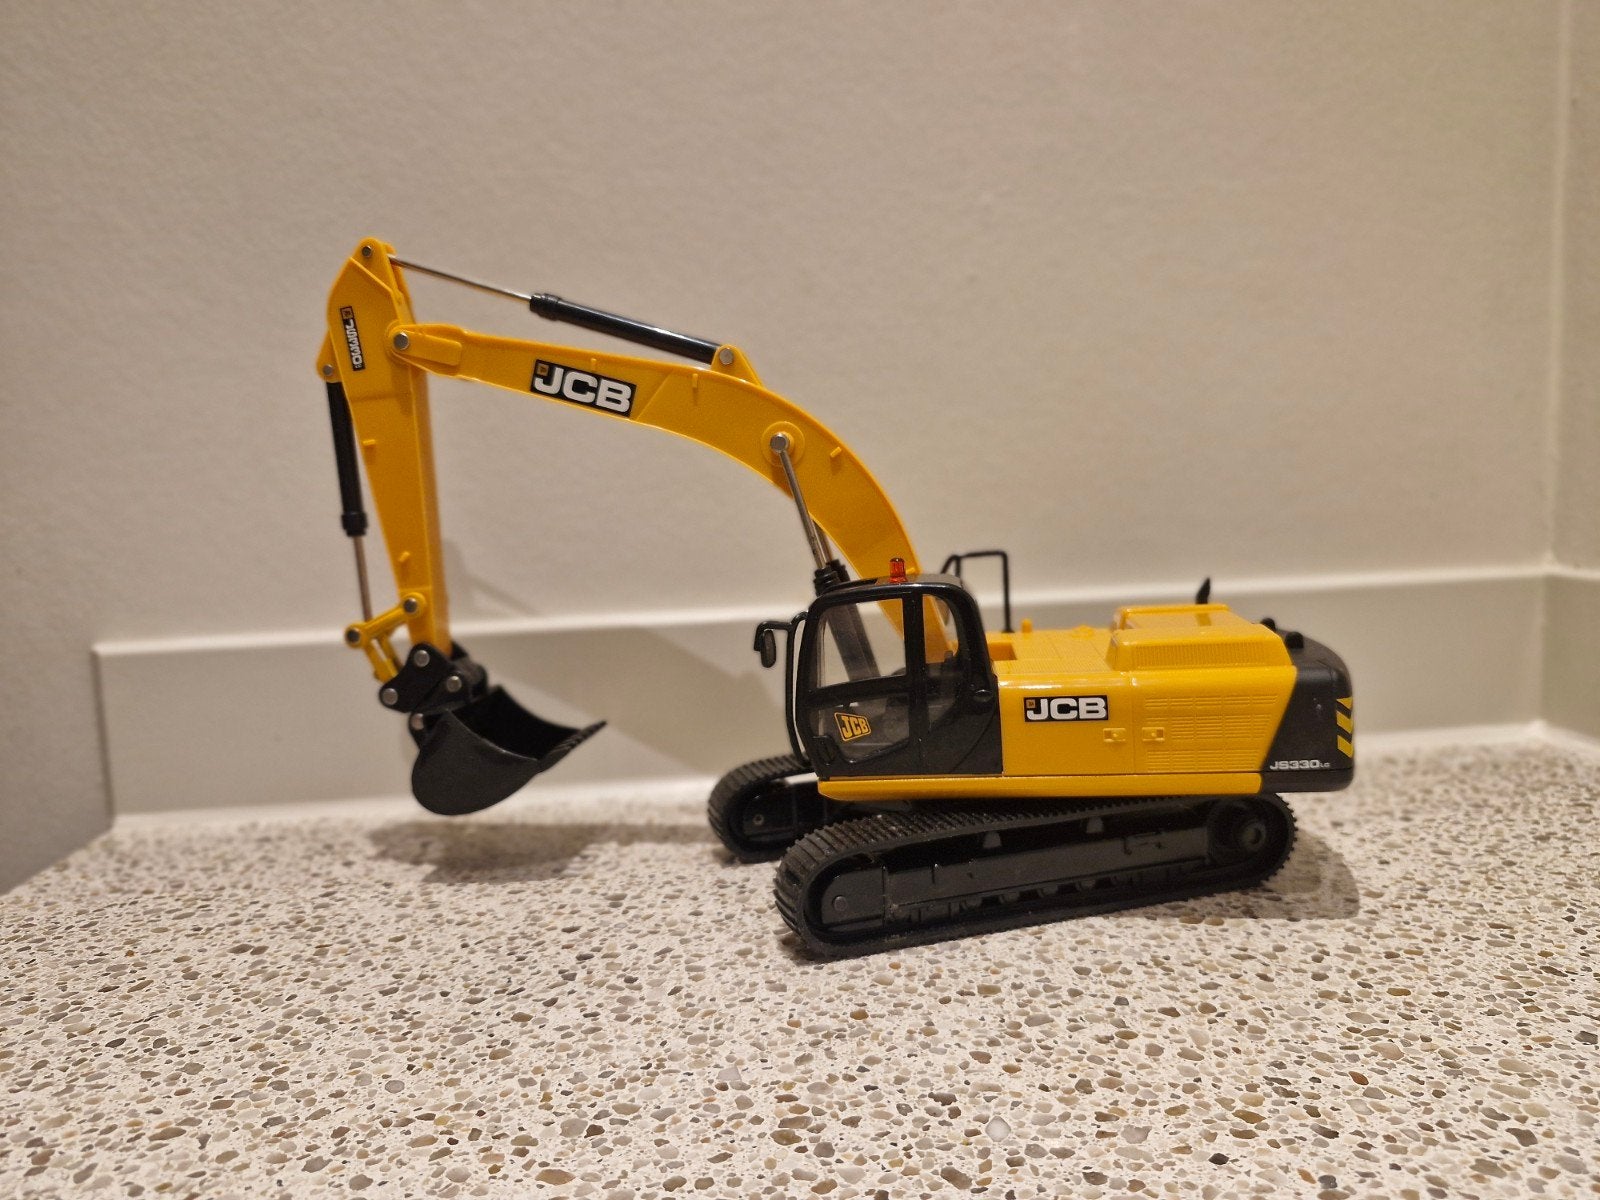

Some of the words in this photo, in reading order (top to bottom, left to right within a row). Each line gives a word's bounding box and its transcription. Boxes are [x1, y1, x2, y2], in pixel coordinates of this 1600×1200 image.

[534, 367, 632, 413] JCB
[1026, 697, 1107, 720] JCB
[841, 715, 869, 739] JCB
